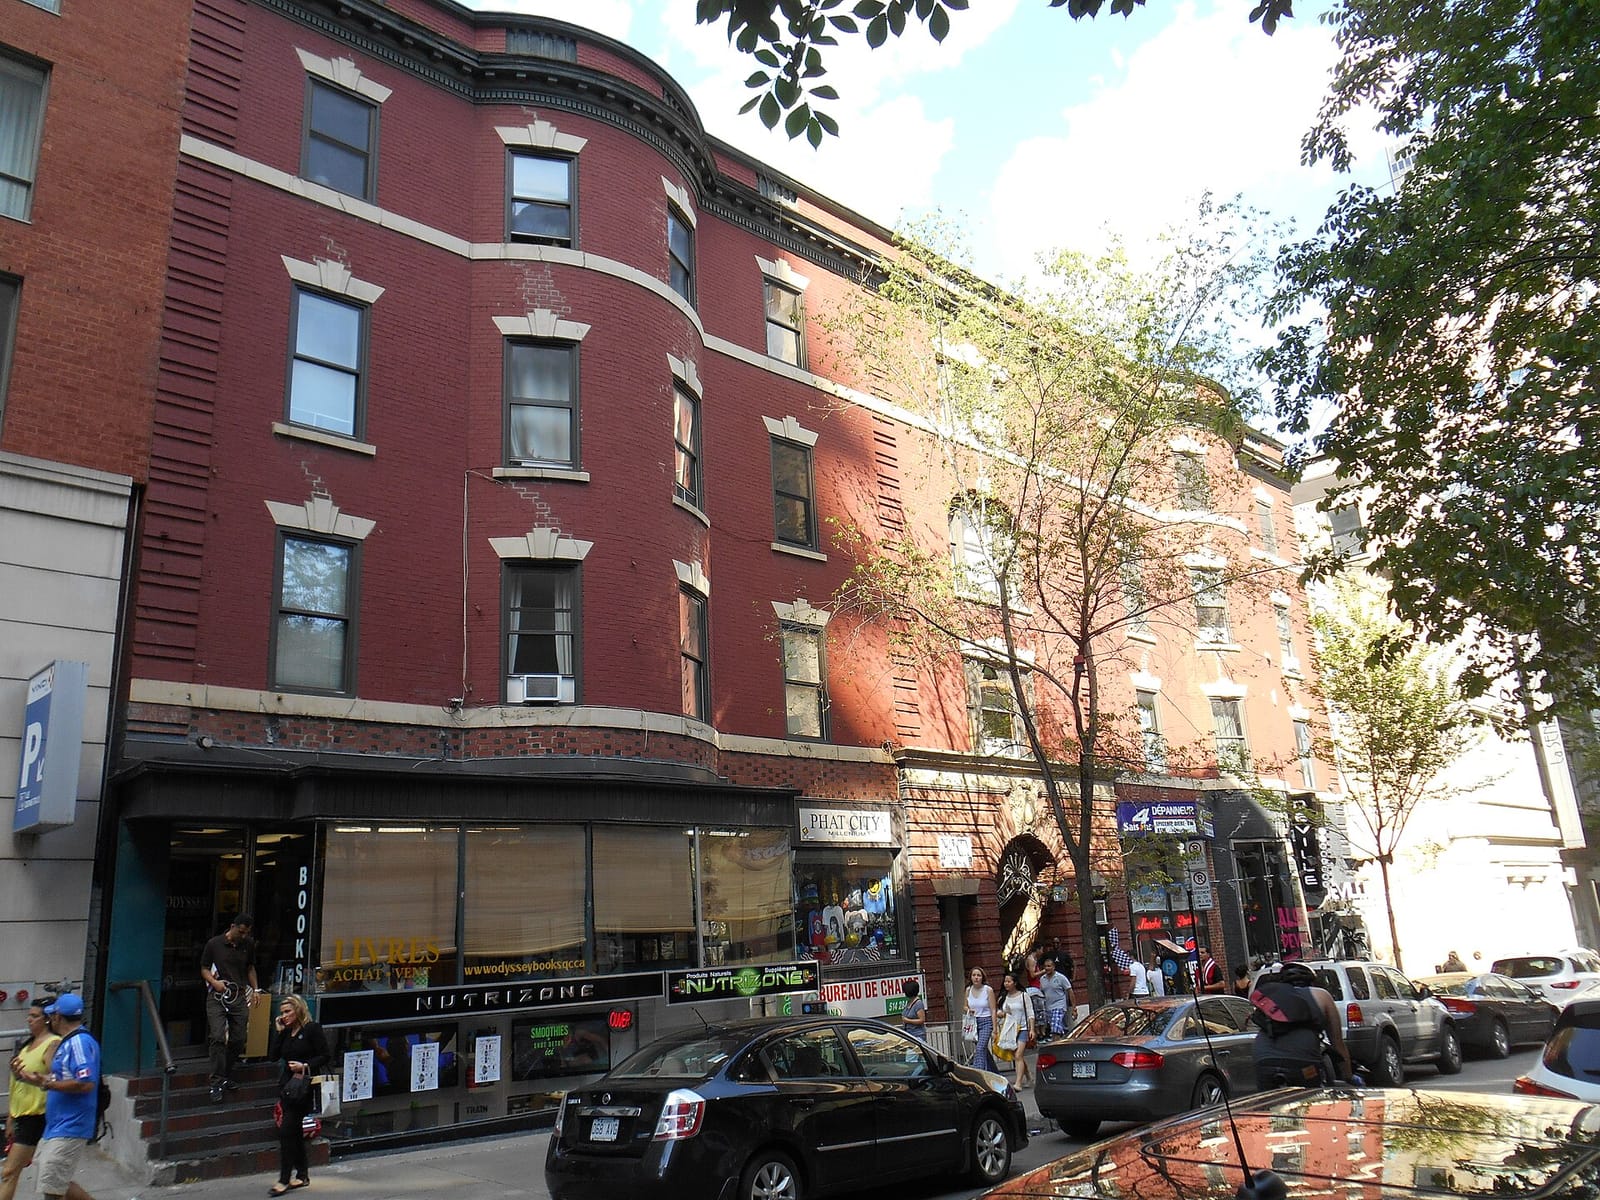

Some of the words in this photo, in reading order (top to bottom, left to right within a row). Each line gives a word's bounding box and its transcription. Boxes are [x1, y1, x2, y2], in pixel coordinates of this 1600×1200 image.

[20, 721, 42, 789] P
[810, 813, 846, 829] PHAT
[849, 815, 880, 831] CITY
[1132, 807, 1150, 824] 4
[295, 866, 308, 983] BOOKS
[335, 936, 440, 966] LIVRES
[333, 968, 383, 982] ACHAT
[686, 970, 803, 994] NUTRIZONE
[416, 984, 594, 1011] NUTRIZONE
[819, 984, 862, 1003] BUREAU
[865, 981, 878, 999] DE
[880, 976, 919, 997] CHAN
[531, 1025, 569, 1038] SMOOTHIES
